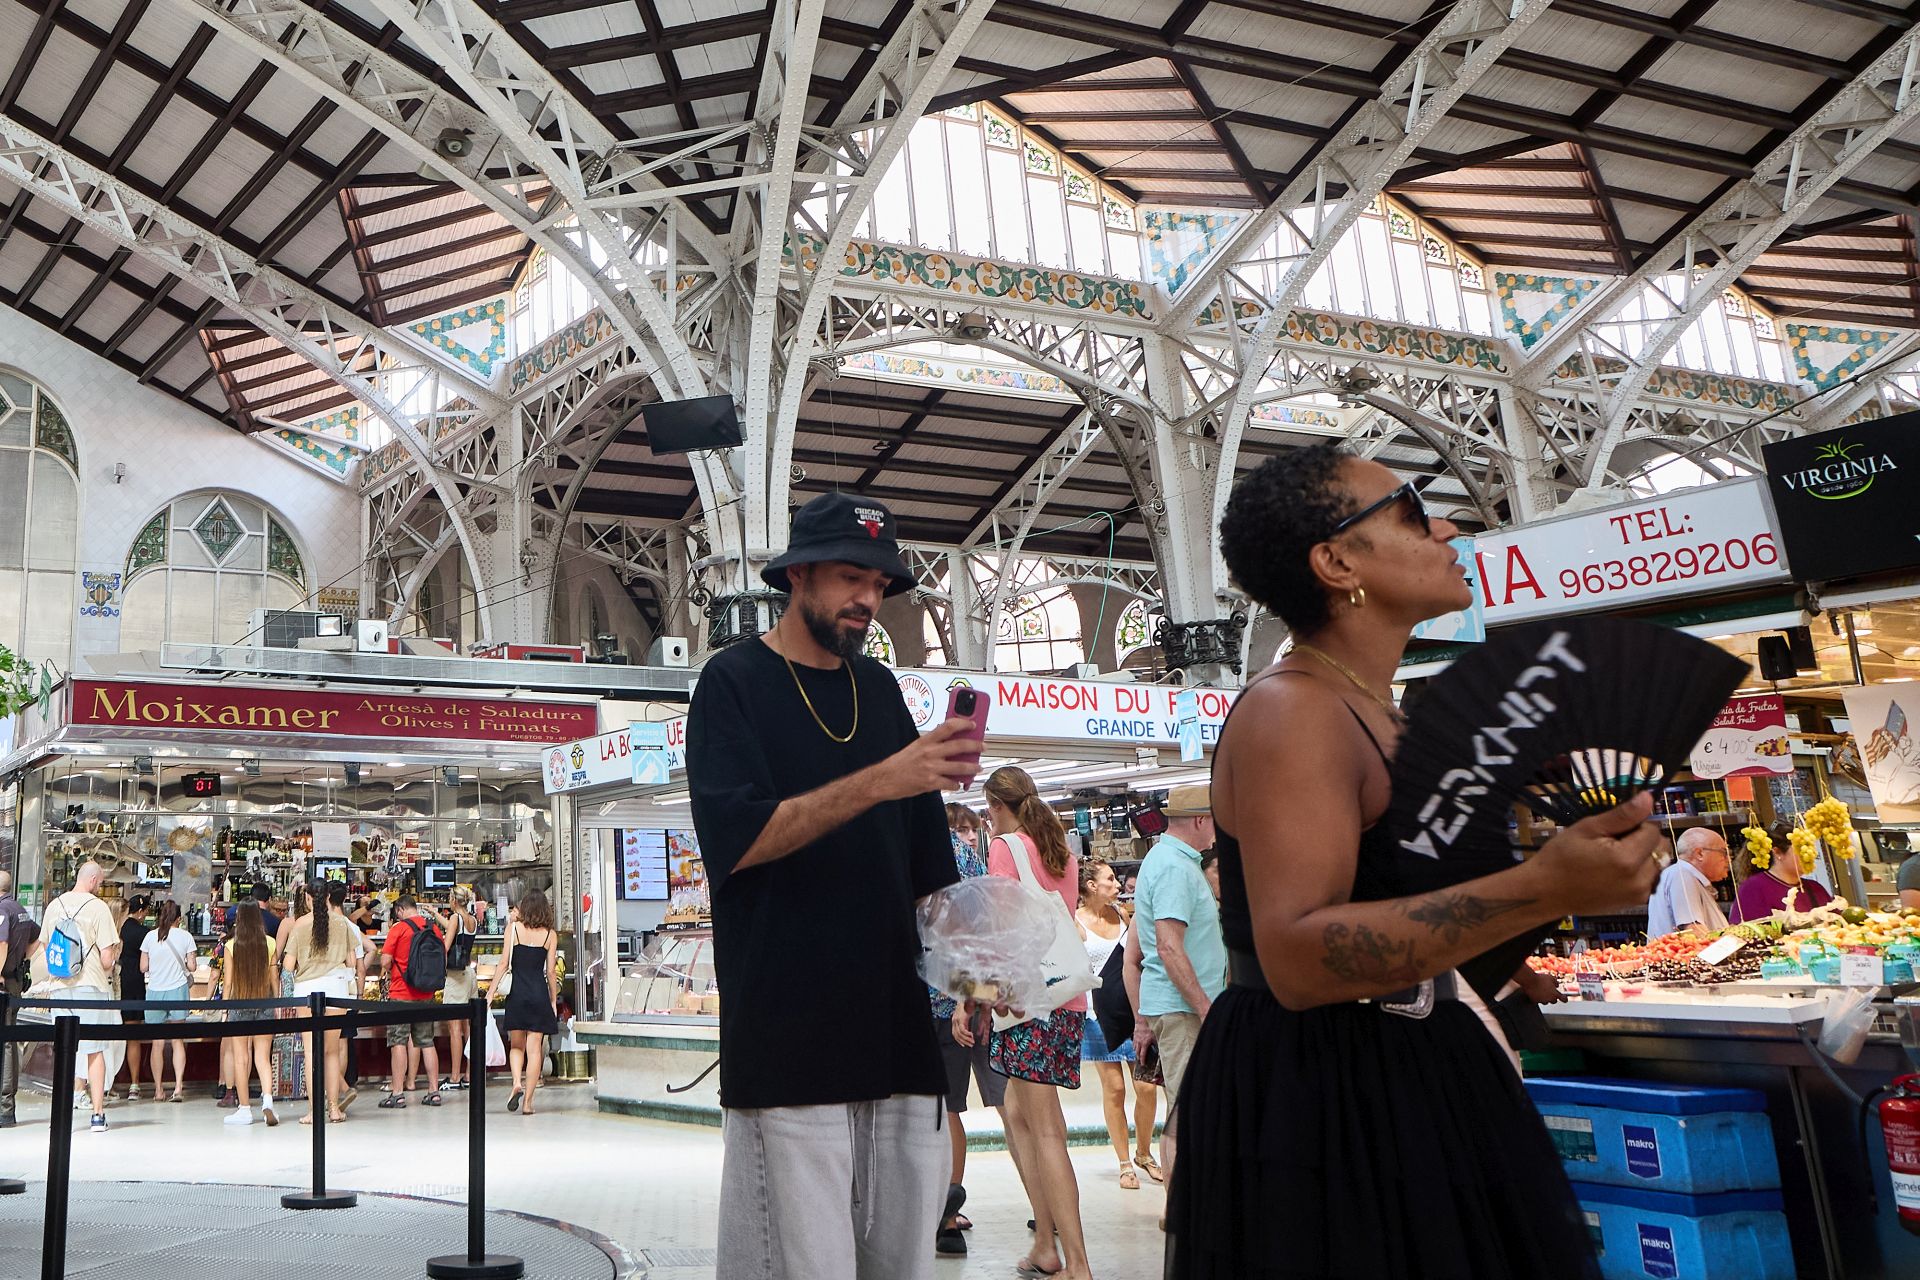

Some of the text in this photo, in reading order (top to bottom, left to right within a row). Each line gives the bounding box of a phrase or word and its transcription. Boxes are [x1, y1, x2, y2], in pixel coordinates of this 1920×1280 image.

[1782, 453, 1897, 490] VIRGINIA
[854, 507, 884, 517] CHICAGO
[860, 514, 881, 522] BULLS
[1610, 507, 1694, 545] TEL:
[1475, 533, 1778, 608] IA 963829206
[998, 681, 1098, 711] MAISON
[1115, 688, 1150, 714] DU
[89, 687, 340, 729] Moixamer
[357, 699, 584, 721] Artesà de Saladura
[1720, 700, 1778, 715] nia de Frutas
[381, 714, 561, 733] Olives i Fumats
[1086, 718, 1156, 738] GRANDE
[1714, 716, 1735, 726] Salad
[600, 738, 616, 761] LA
[196, 780, 212, 791] 01
[1627, 1139, 1655, 1150] makro
[1642, 1238, 1671, 1250] makro
